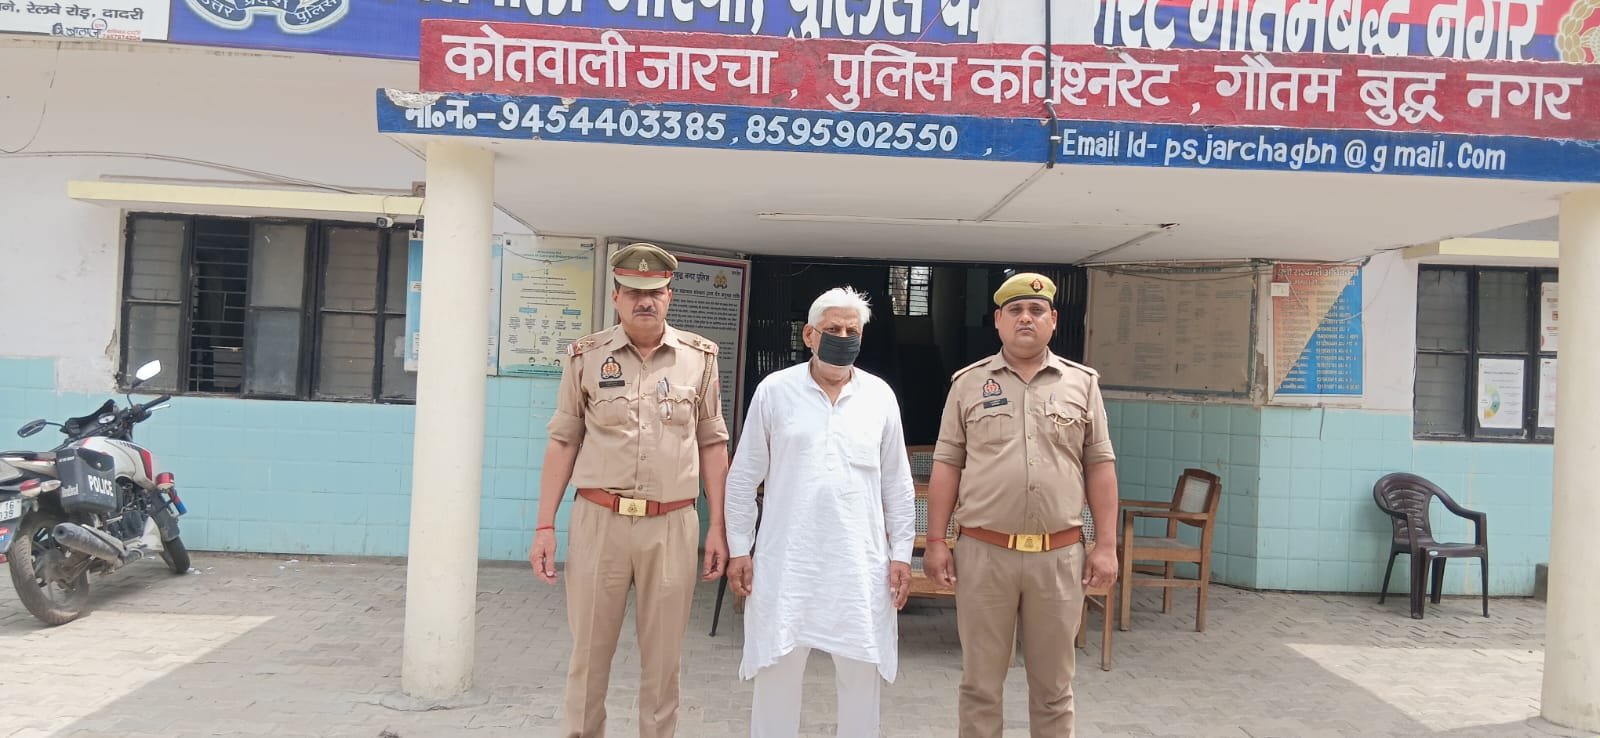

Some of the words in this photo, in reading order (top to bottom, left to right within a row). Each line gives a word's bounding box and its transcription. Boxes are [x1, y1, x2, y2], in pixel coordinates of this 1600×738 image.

[26, 2, 61, 15] रेलवे
[102, 7, 144, 20] दादरी
[1427, 0, 1543, 60] नगर
[441, 23, 635, 87] कोतवाली
[636, 44, 779, 94] जारचा
[826, 43, 958, 111] पुलिस
[967, 45, 1179, 107] कमिश्नरेट
[1214, 53, 1342, 113] गौतम
[1356, 68, 1446, 126] बुद्ध
[1466, 73, 1583, 120] नगर
[746, 114, 958, 151] 8595902550
[1062, 128, 1120, 157] Email
[87, 474, 114, 497] POLICE
